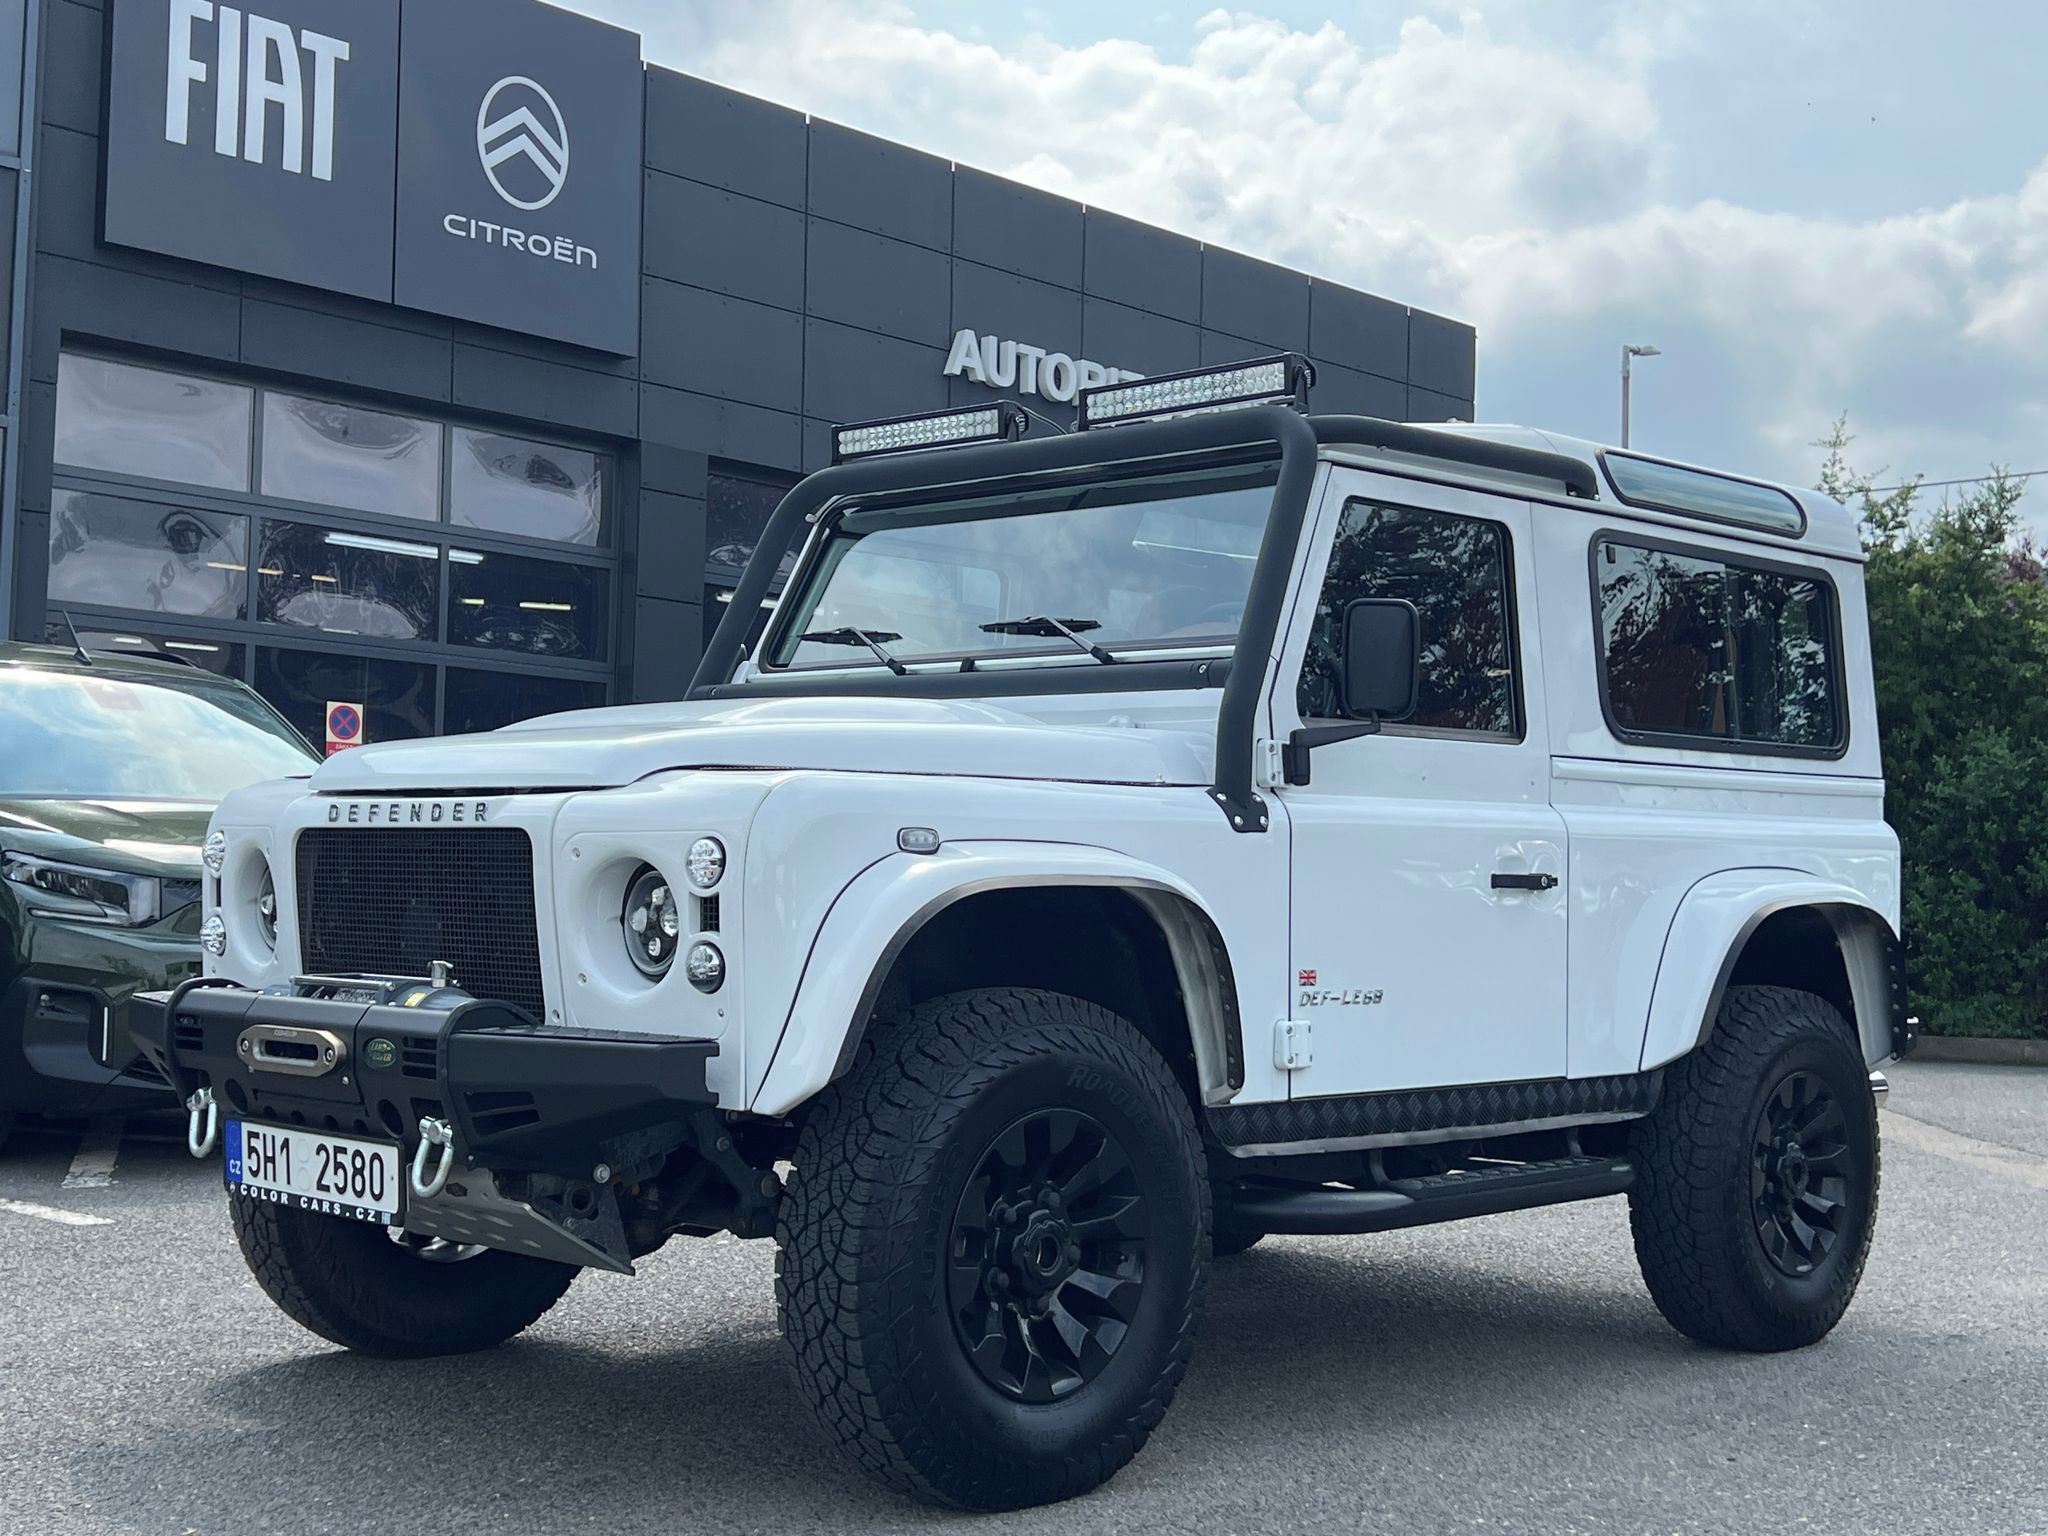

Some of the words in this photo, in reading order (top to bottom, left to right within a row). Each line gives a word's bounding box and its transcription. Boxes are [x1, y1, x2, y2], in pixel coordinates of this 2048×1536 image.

[165, 0, 350, 181] FIAT
[443, 214, 598, 269] CITROËN
[943, 328, 1145, 407] AUTOP
[328, 802, 488, 823] DEFENDER
[230, 1160, 241, 1175] CZ
[247, 1130, 291, 1185] 5H1
[315, 1143, 384, 1202] 2580
[240, 1184, 288, 1204] COLOR
